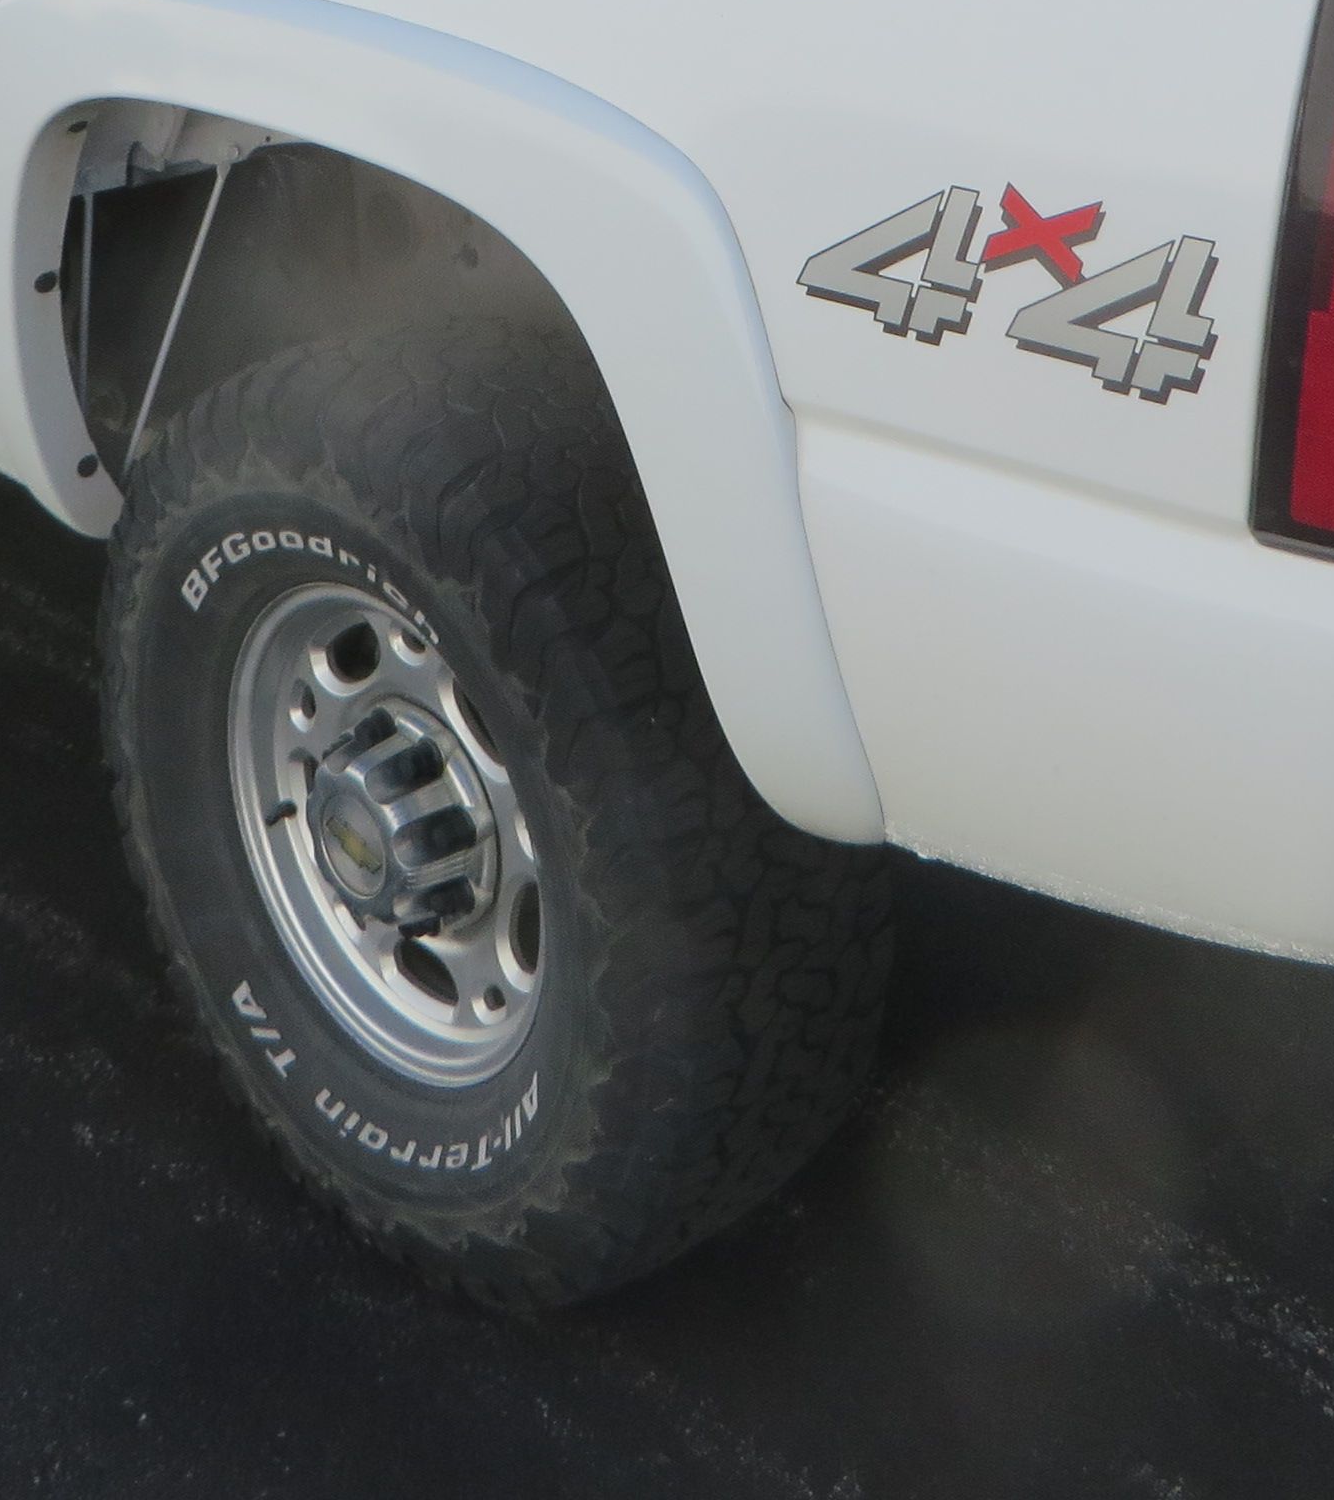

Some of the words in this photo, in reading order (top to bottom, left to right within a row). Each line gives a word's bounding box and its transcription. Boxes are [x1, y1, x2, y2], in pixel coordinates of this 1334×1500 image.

[181, 531, 439, 645] BFGoodrich
[232, 980, 296, 1078] T/A
[315, 1070, 539, 1171] All-Terrain
